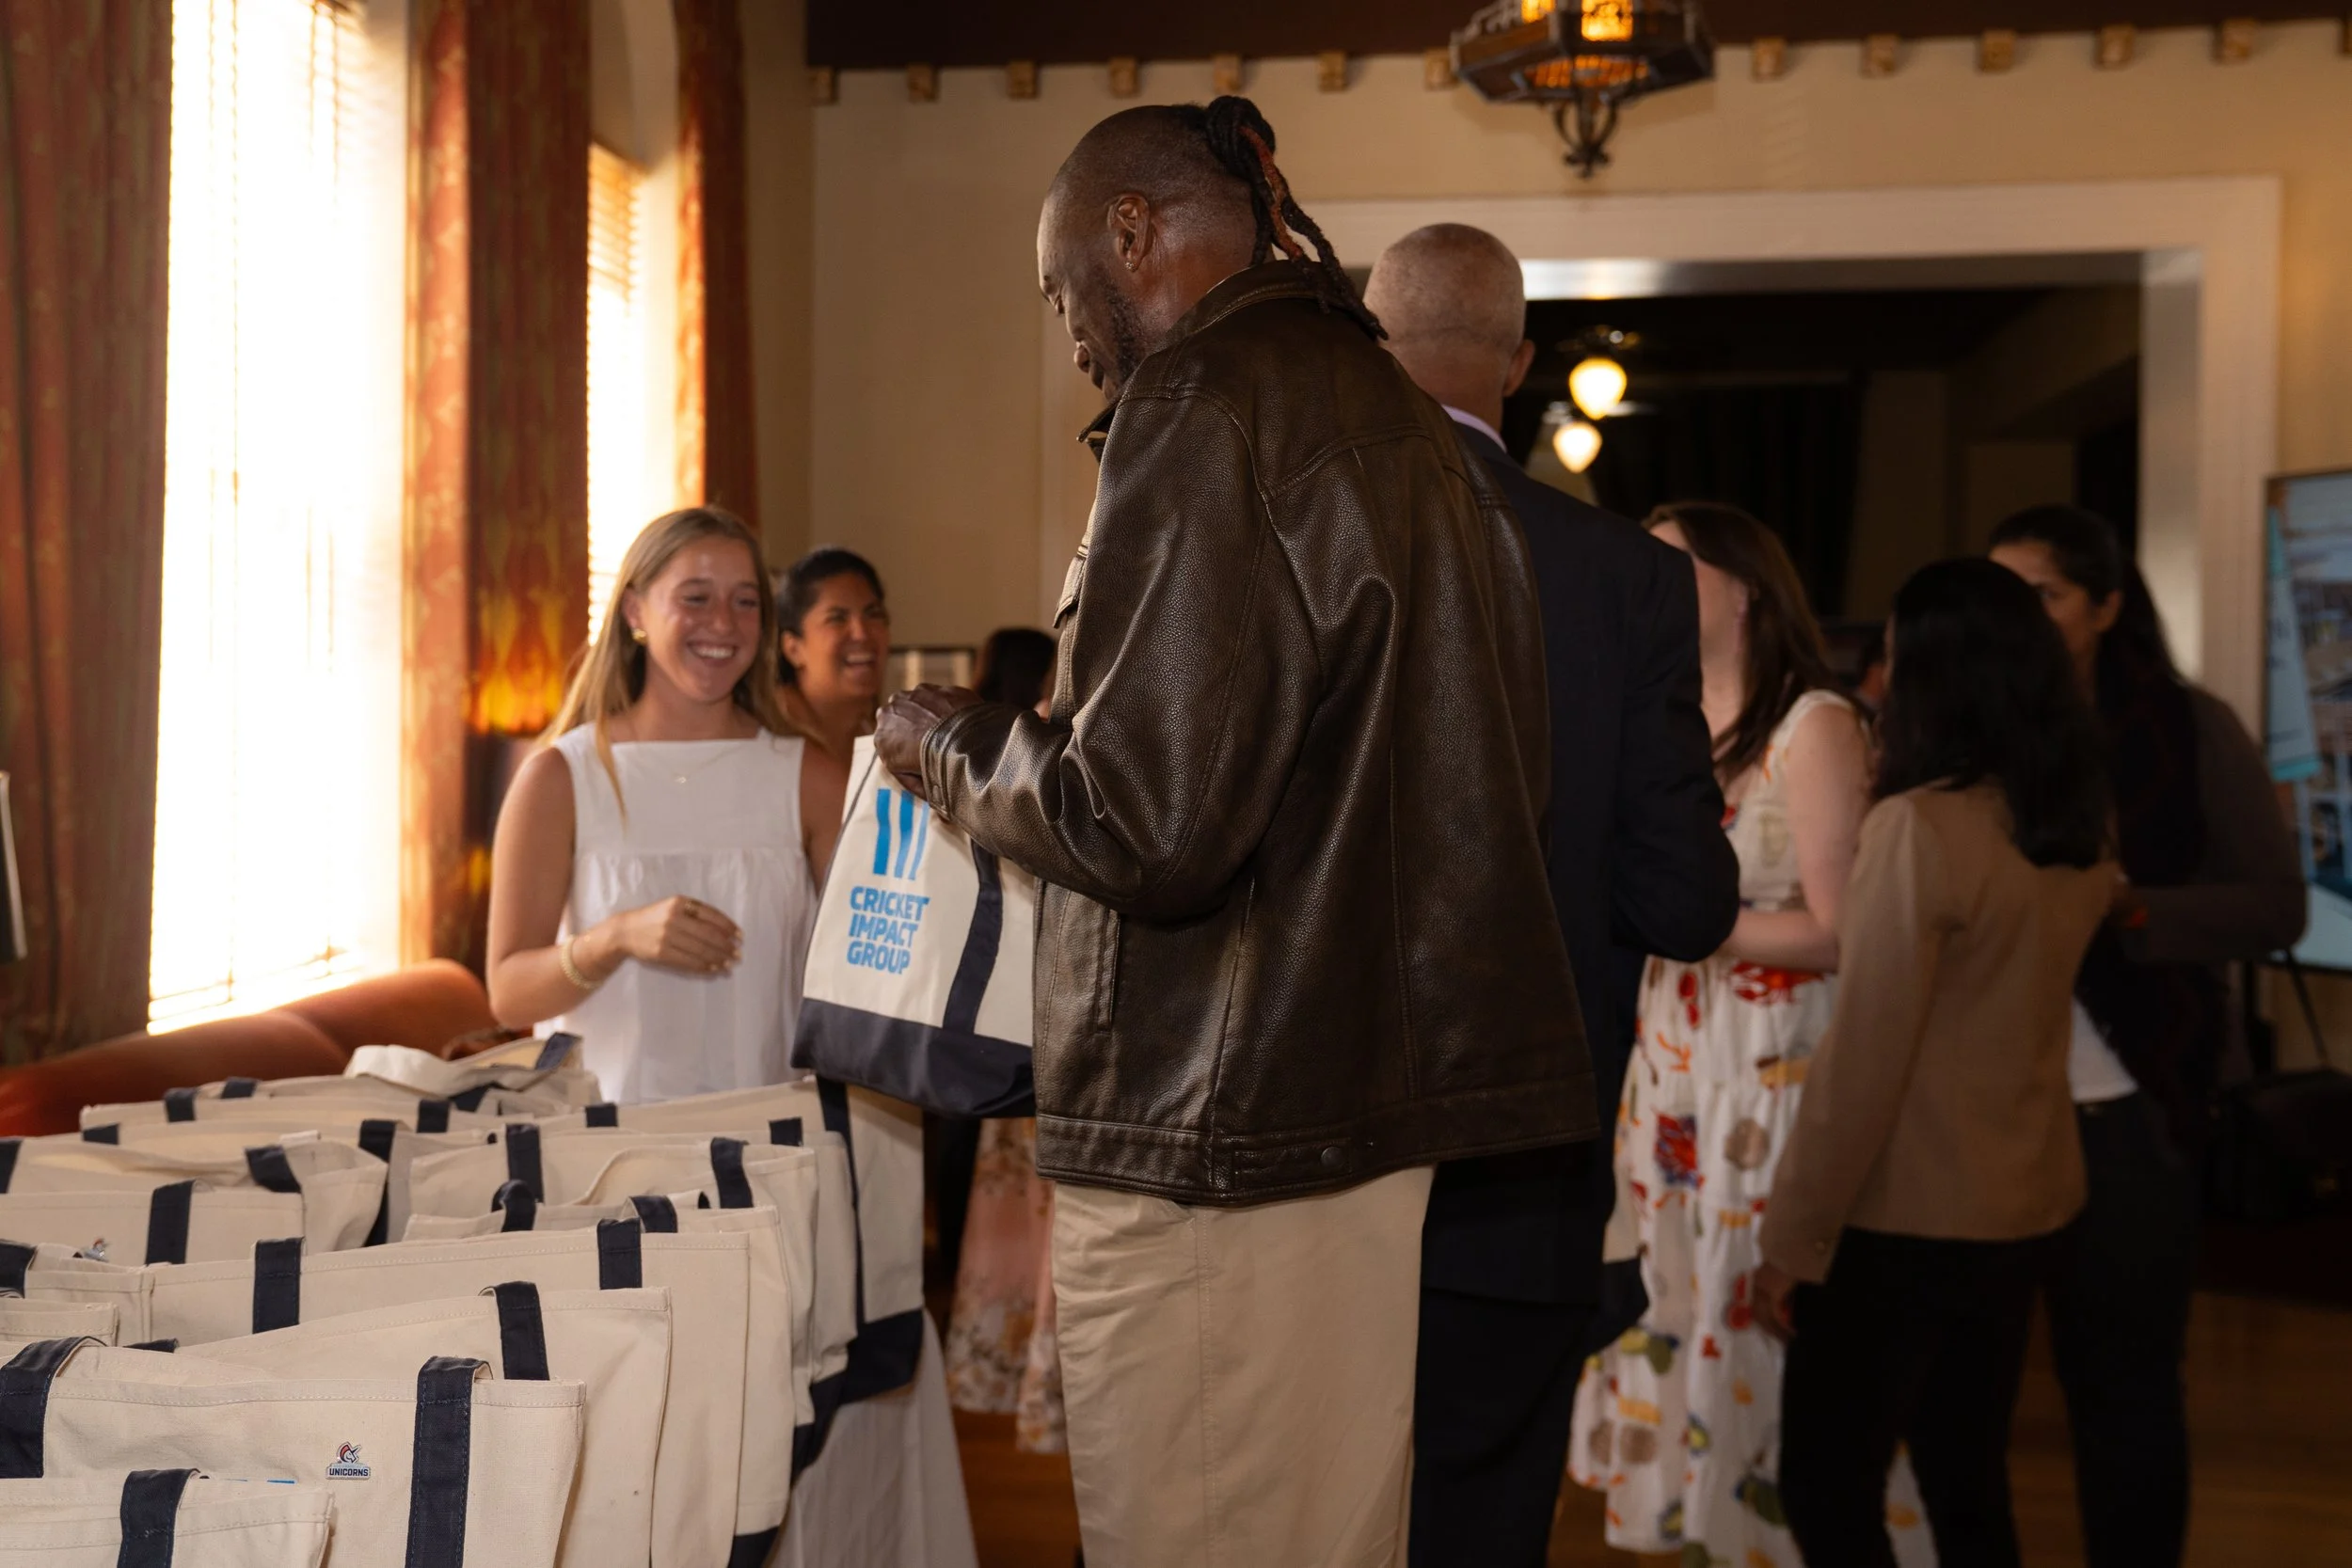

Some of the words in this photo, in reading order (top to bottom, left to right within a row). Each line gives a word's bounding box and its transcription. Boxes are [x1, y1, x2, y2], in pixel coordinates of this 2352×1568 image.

[850, 886, 930, 922] CRICKET
[849, 912, 918, 948] IMPACT
[847, 941, 911, 974] GROUP
[329, 1467, 369, 1477] UNICORNS
